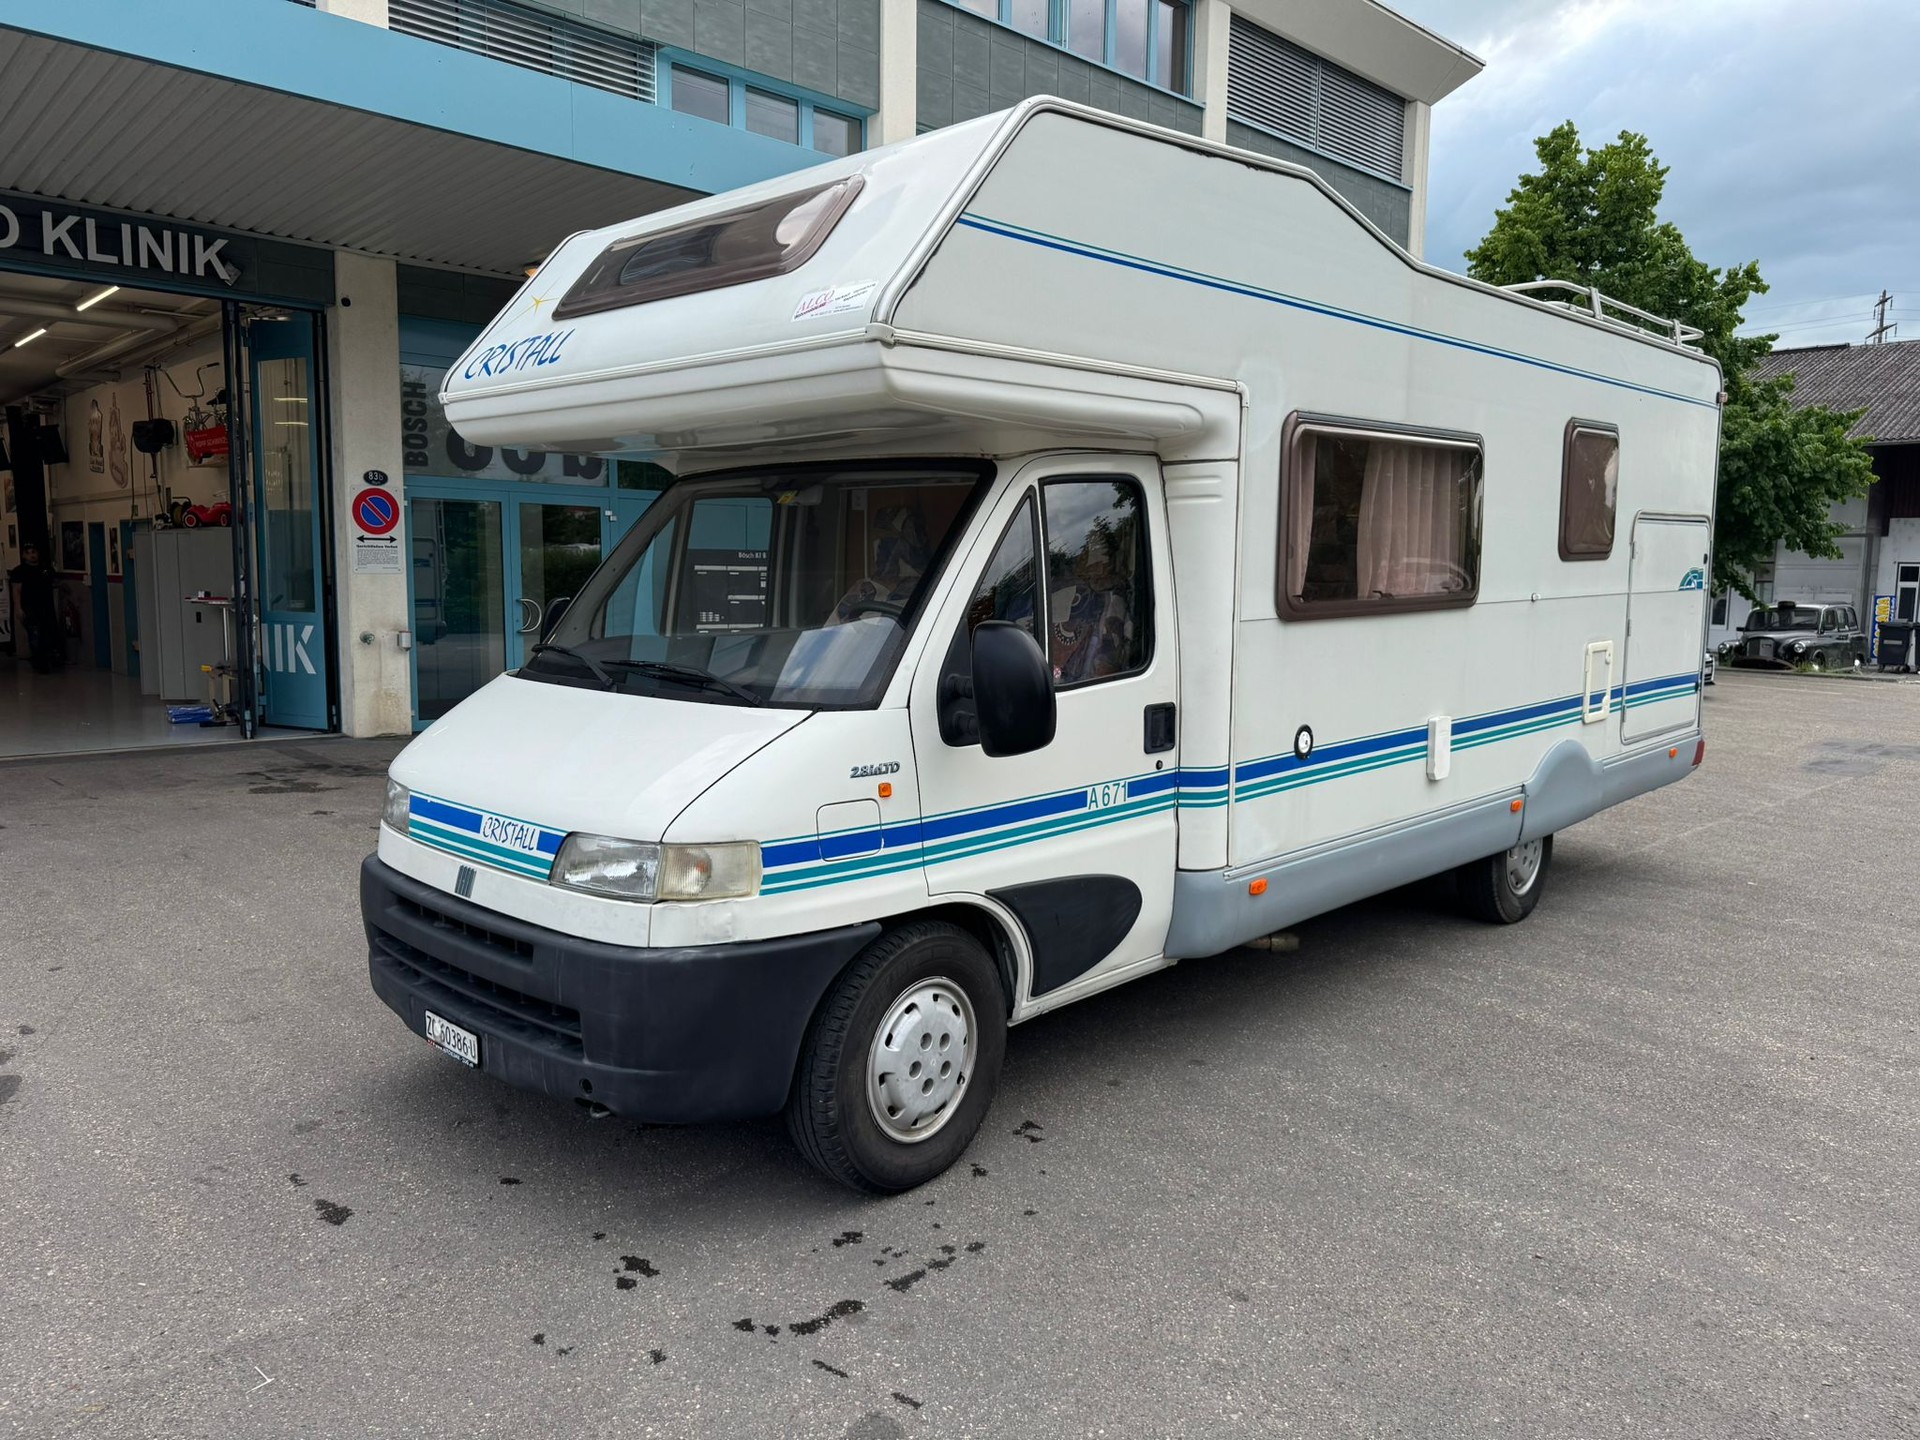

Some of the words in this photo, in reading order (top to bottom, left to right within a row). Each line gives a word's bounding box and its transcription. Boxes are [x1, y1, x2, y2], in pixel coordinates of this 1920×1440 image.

[41, 210, 231, 281] KLINIK
[464, 328, 576, 379] CRISTALL
[368, 471, 384, 481] 83b
[483, 816, 536, 850] CRISTALL
